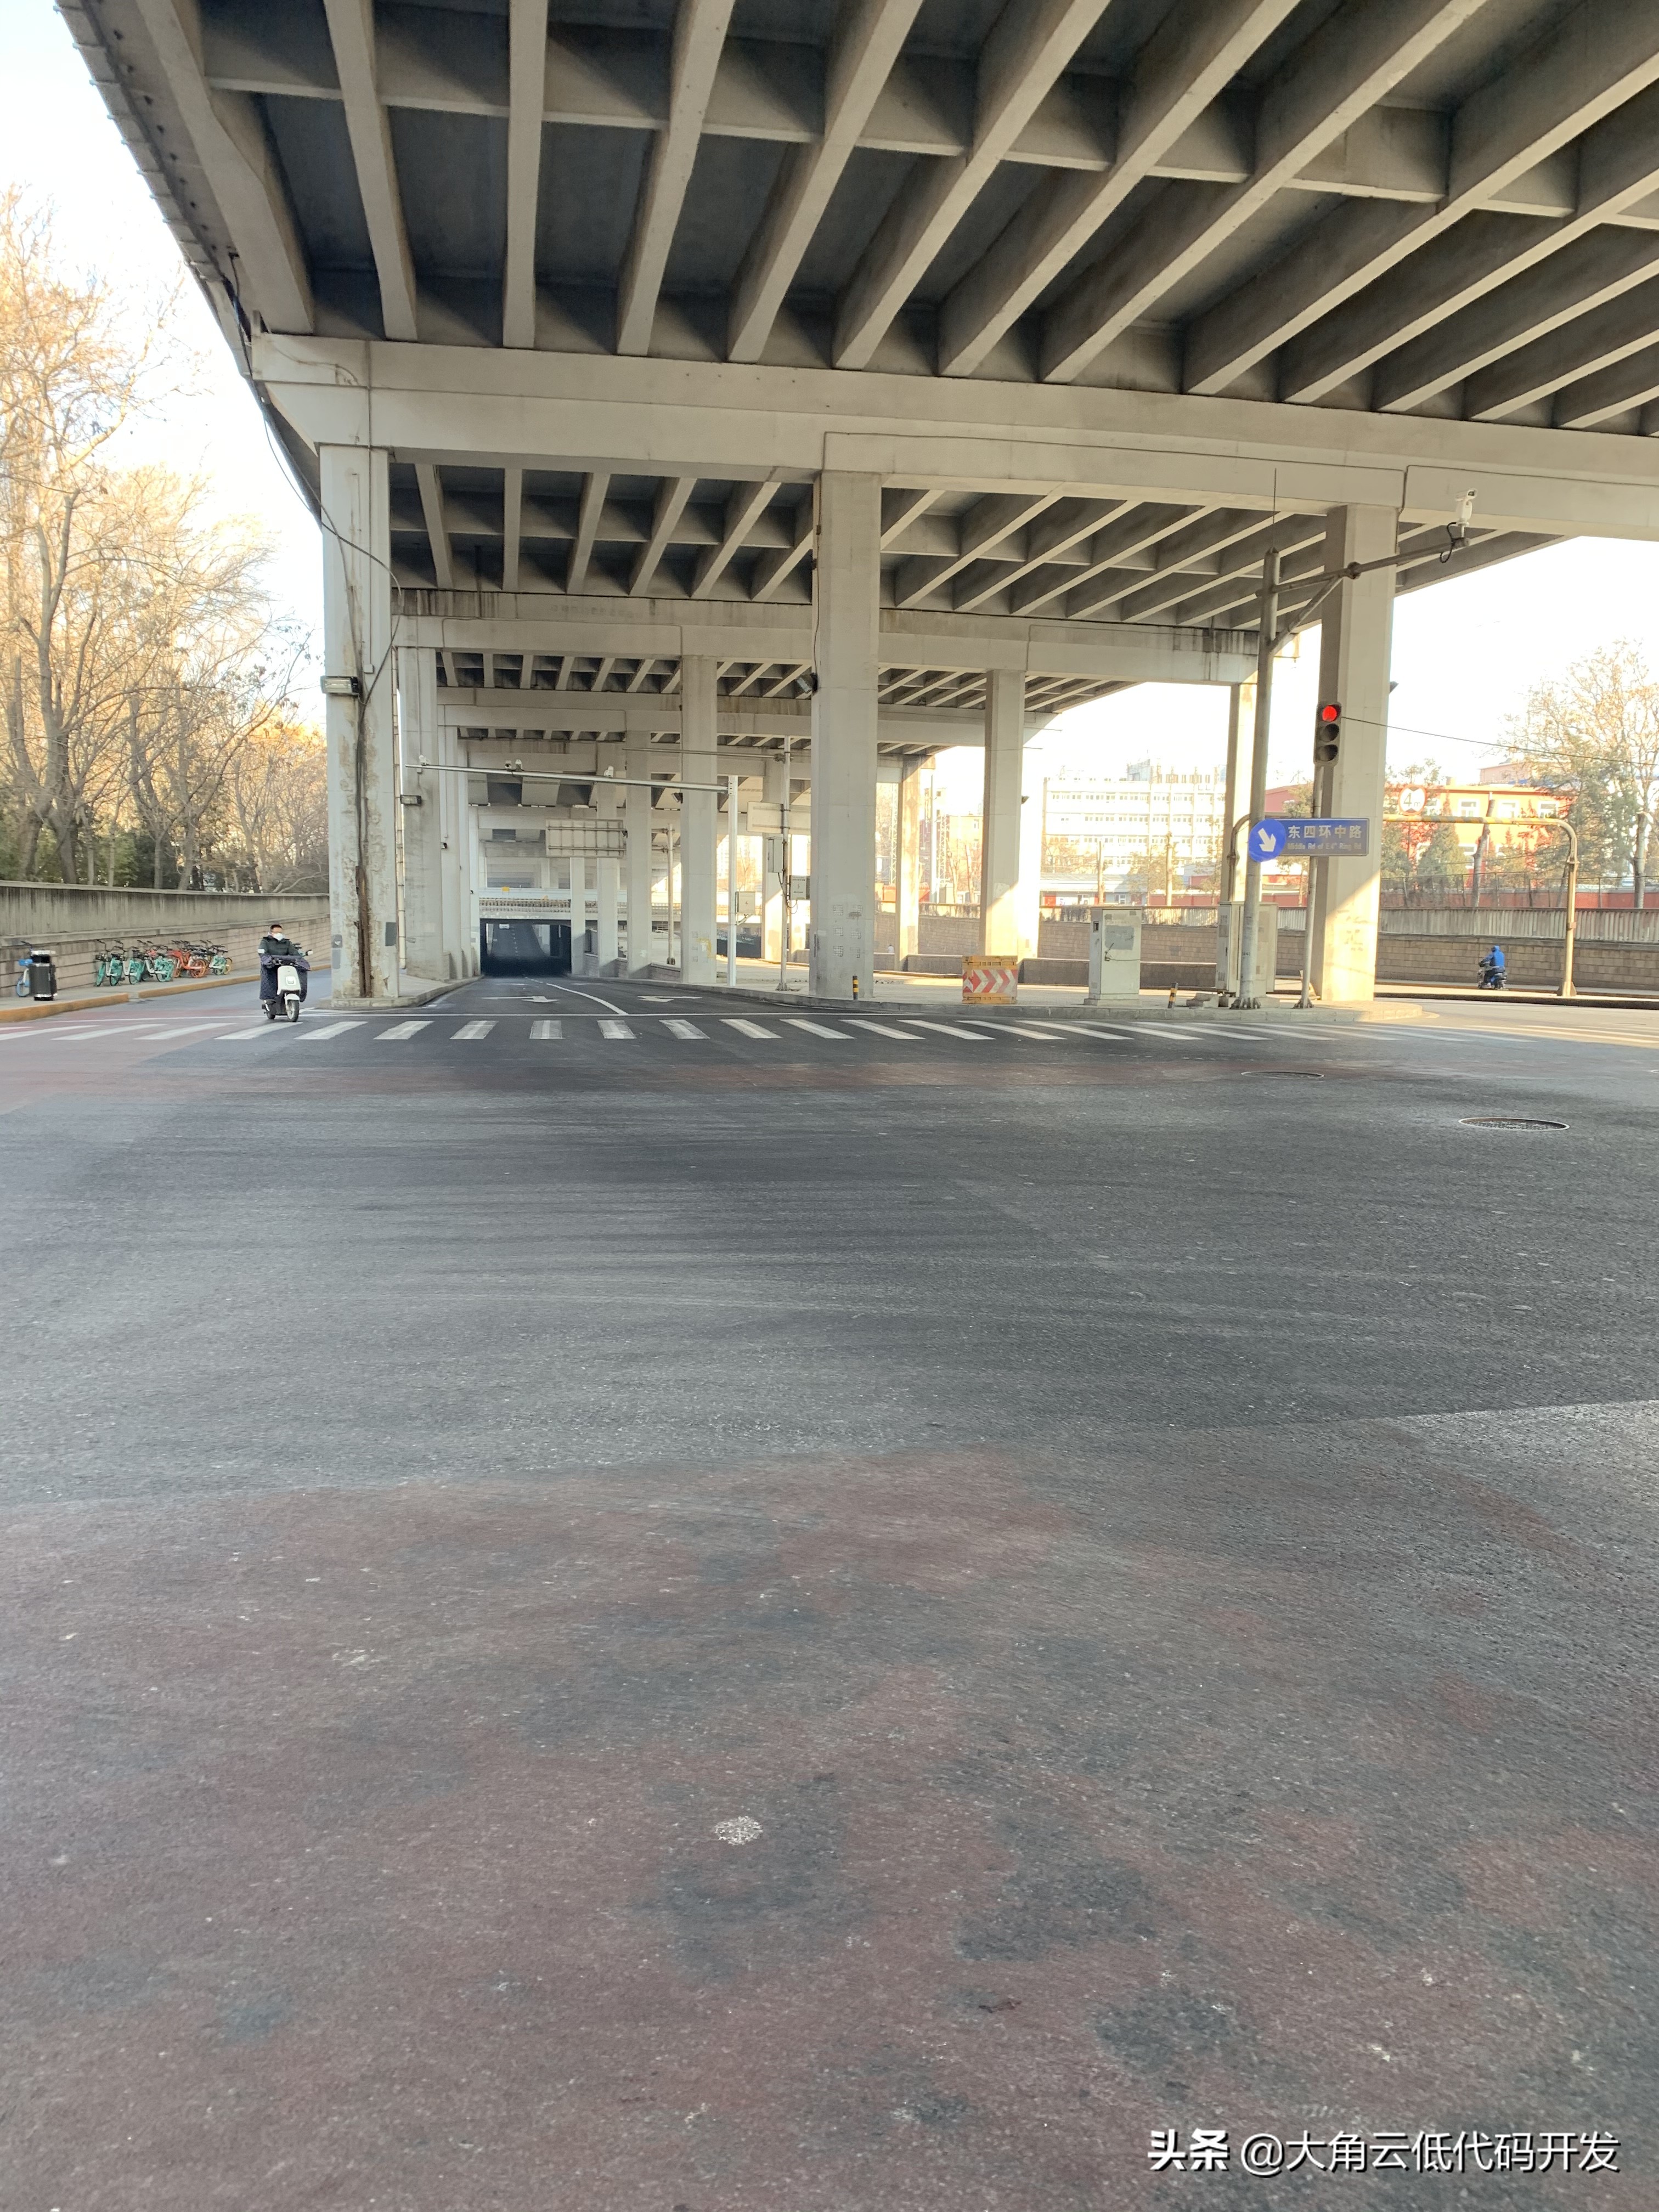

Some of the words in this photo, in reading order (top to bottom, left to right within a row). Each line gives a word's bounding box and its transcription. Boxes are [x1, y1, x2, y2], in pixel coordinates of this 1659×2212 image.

[1288, 825, 1362, 839] 东四环中路
